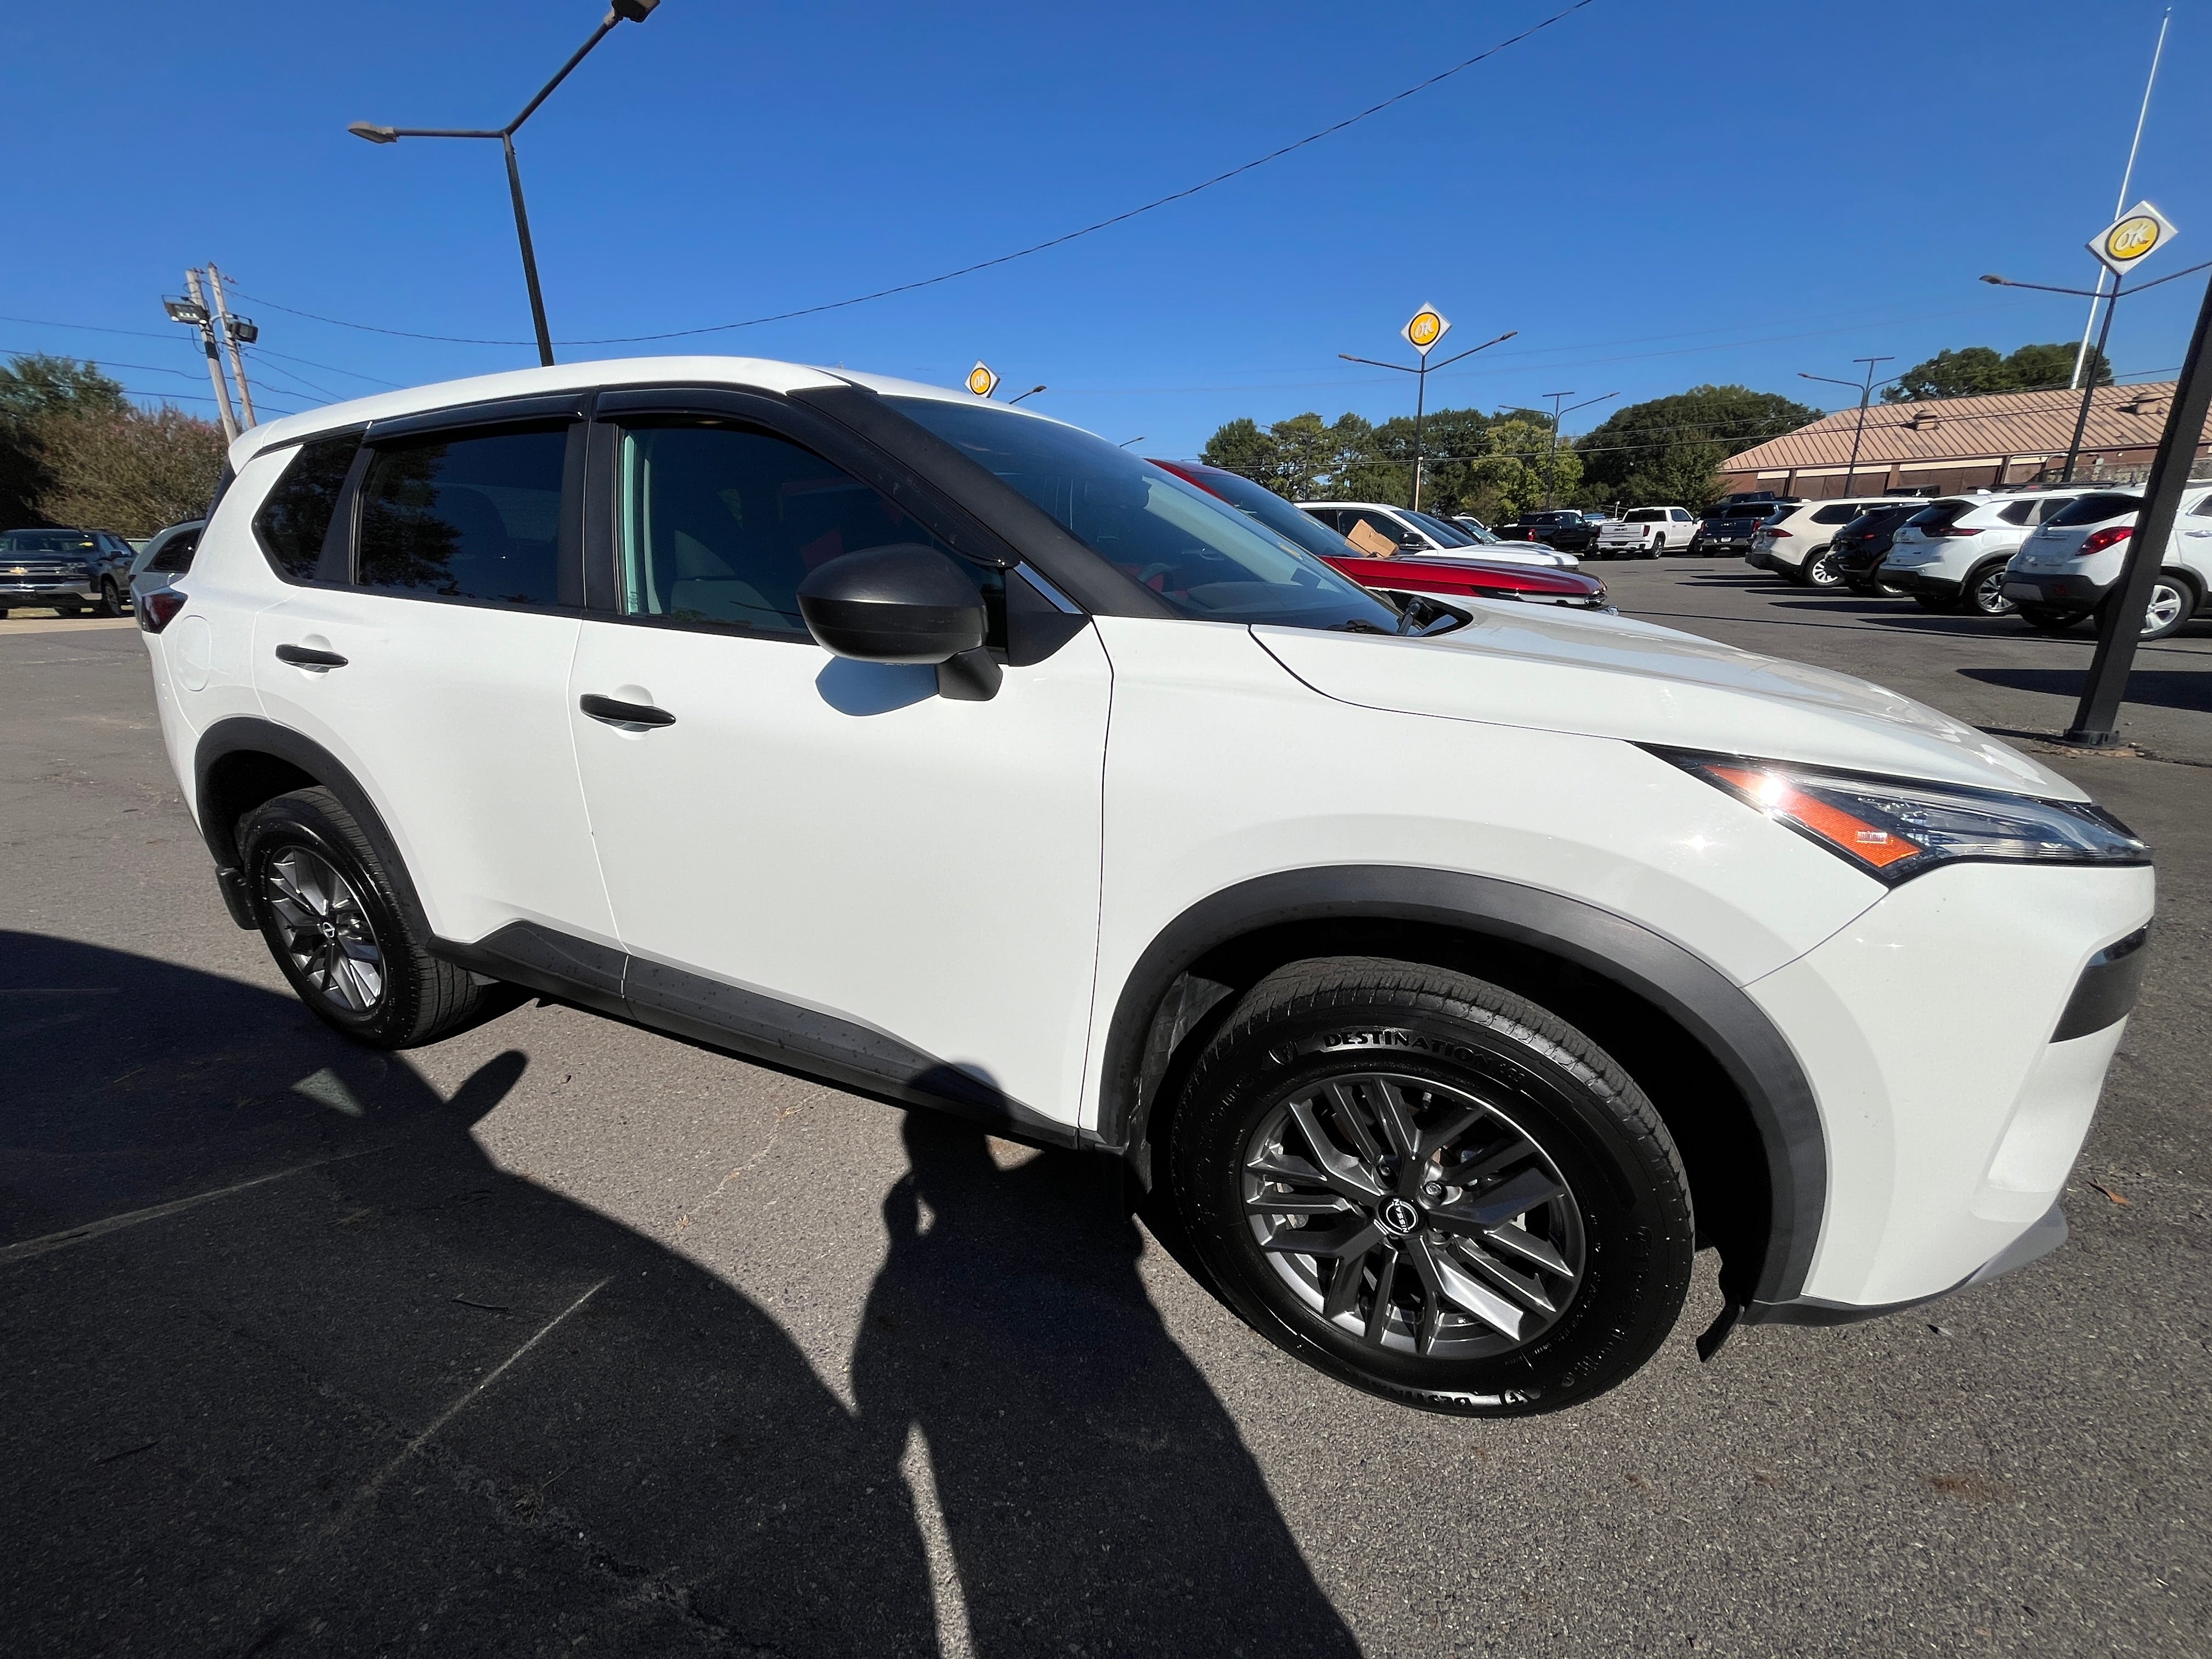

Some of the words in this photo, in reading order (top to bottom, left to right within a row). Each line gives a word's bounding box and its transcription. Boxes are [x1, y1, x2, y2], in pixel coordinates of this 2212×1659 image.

[2113, 222, 2149, 252] OK
[1414, 317, 1435, 338] OK
[973, 371, 987, 389] OK
[1323, 1030, 1493, 1071] DESTINATION
[1392, 1197, 1409, 1233] NISSAN
